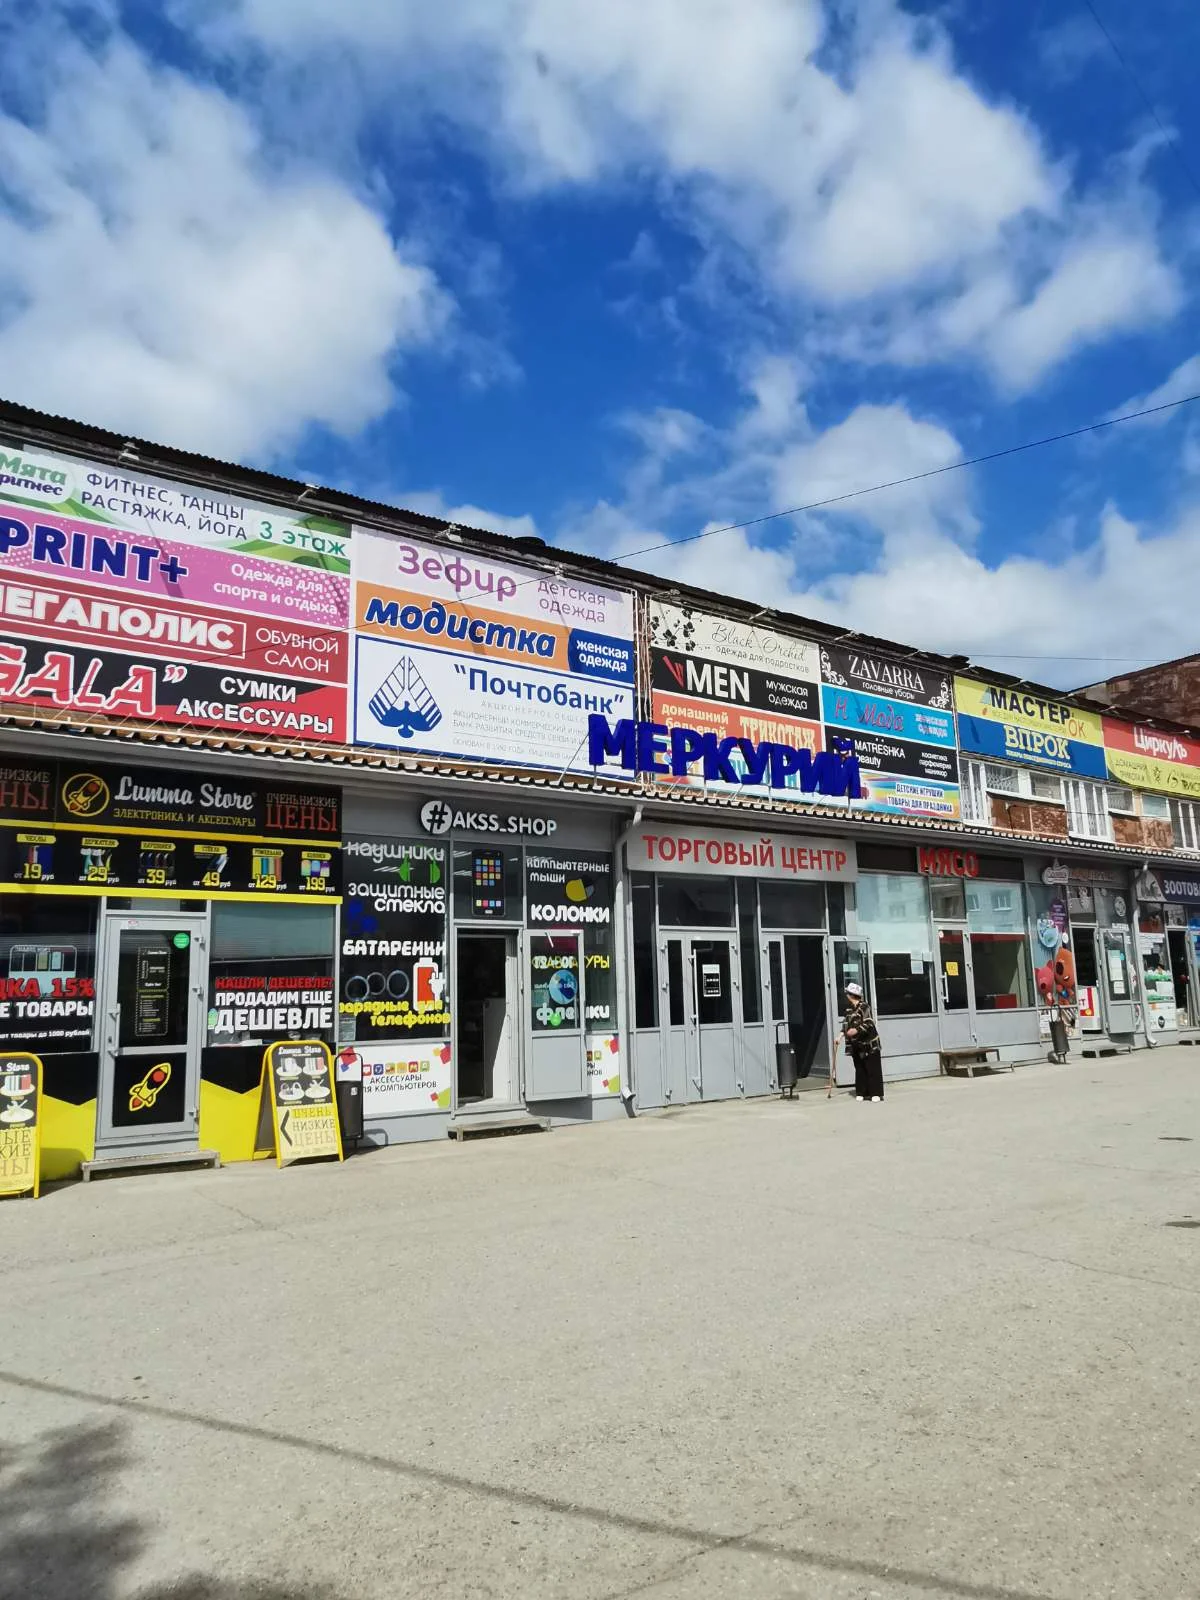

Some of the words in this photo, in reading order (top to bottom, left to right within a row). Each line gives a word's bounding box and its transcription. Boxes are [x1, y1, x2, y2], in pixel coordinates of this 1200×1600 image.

[86, 473, 172, 507] ФИТНЕС,
[180, 494, 244, 520] ТАНЦЫ
[81, 491, 191, 530] РАСТЯЖКА,
[198, 513, 247, 540] ЙОГА
[259, 520, 272, 540] 3
[282, 529, 346, 556] этаж
[231, 562, 293, 588] Одежда
[296, 578, 324, 596] для
[398, 545, 517, 601] Зефир
[214, 582, 267, 603] спорта
[271, 591, 281, 604] и
[284, 592, 338, 616] отдыха
[538, 578, 606, 606] детская
[0, 584, 234, 650] ЕГАПОЛИС
[539, 599, 606, 624] одежда
[365, 598, 556, 658] модистка
[256, 628, 338, 654] ОБУВНОЙ
[576, 638, 630, 660] женская
[712, 622, 753, 648] Black
[762, 636, 808, 662] Orchid
[264, 650, 329, 673] САЛОН
[579, 652, 628, 673] одежда
[716, 646, 747, 659] одежда
[749, 653, 764, 662] для
[766, 658, 809, 674] подростков
[848, 654, 925, 692] ZAVARRA
[220, 676, 296, 703] СУМКИ
[862, 682, 894, 695] головные
[894, 688, 915, 700] уборы
[176, 698, 333, 734] АКСЕССУАРЫ
[662, 704, 729, 725] домашний
[1004, 724, 1071, 760] ВПРОК
[1134, 726, 1188, 760] Циркуль
[588, 714, 862, 799] МЕРКУРИЙ
[114, 775, 195, 806] Lumma
[200, 782, 254, 810] Store
[300, 795, 337, 808] НИЗКИЕ
[113, 808, 184, 822] ЭЛЕКТРОНИКА
[187, 814, 194, 822] И
[198, 814, 256, 828] АКСЕССУАРЫ
[264, 803, 337, 832] ЦЕНЫ
[642, 834, 775, 868] ТОРГОВЫЙ
[780, 846, 847, 874] ЦЕНТР
[917, 847, 978, 878] МЯСО
[24, 862, 42, 879] 19
[42, 873, 54, 881] руб
[87, 865, 108, 882] 29
[107, 876, 120, 884] руб
[146, 868, 166, 884] 39
[164, 878, 176, 886] руб
[201, 872, 220, 887] 49
[220, 880, 232, 888] руб
[255, 874, 277, 889] 129
[306, 876, 326, 891] 199
[348, 882, 445, 900] защитные
[1164, 880, 1200, 897] ЗООТОВ
[374, 898, 446, 914] стекла
[531, 904, 610, 924] КОЛОНКИ
[52, 978, 96, 998] 15%
[216, 976, 265, 990] НАШЛИ
[16, 1001, 94, 1018] ТОВАРЫ
[215, 992, 299, 1006] ПРОДАДИМ
[302, 990, 333, 1006] ЕЩЕ
[214, 1007, 333, 1034] ДЕШЕВЛЕ
[370, 1010, 451, 1029] телефонов
[370, 1074, 422, 1085] АКСЕССУАРЫ
[374, 1082, 437, 1092] КОМПЬЮТЕРОВ
[292, 1119, 336, 1132] НИЗКИЕ
